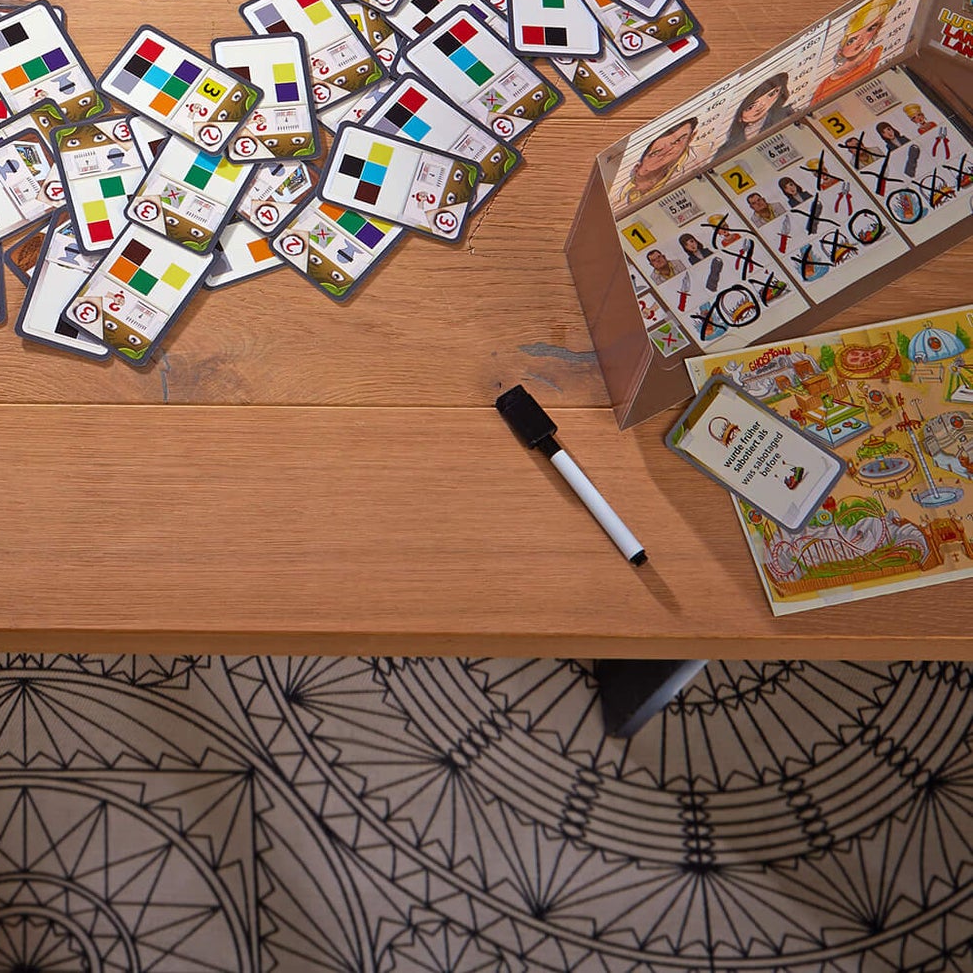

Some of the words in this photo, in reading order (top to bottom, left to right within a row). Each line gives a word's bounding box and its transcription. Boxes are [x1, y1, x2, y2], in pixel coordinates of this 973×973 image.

[940, 9, 973, 33] LUC
[942, 36, 973, 58] LAN
[204, 84, 220, 96] 3
[828, 116, 846, 133] 3
[240, 140, 251, 154] 3
[730, 172, 749, 189] 2
[261, 210, 273, 222] 4
[632, 228, 646, 244] 1
[80, 306, 93, 322] 3
[724, 446, 744, 468] wurde
[741, 420, 761, 445] früher
[733, 440, 759, 474] sabotiert
[758, 429, 769, 441] als
[742, 471, 756, 486] was
[754, 432, 784, 470] sabotaged
[761, 452, 782, 477] before
